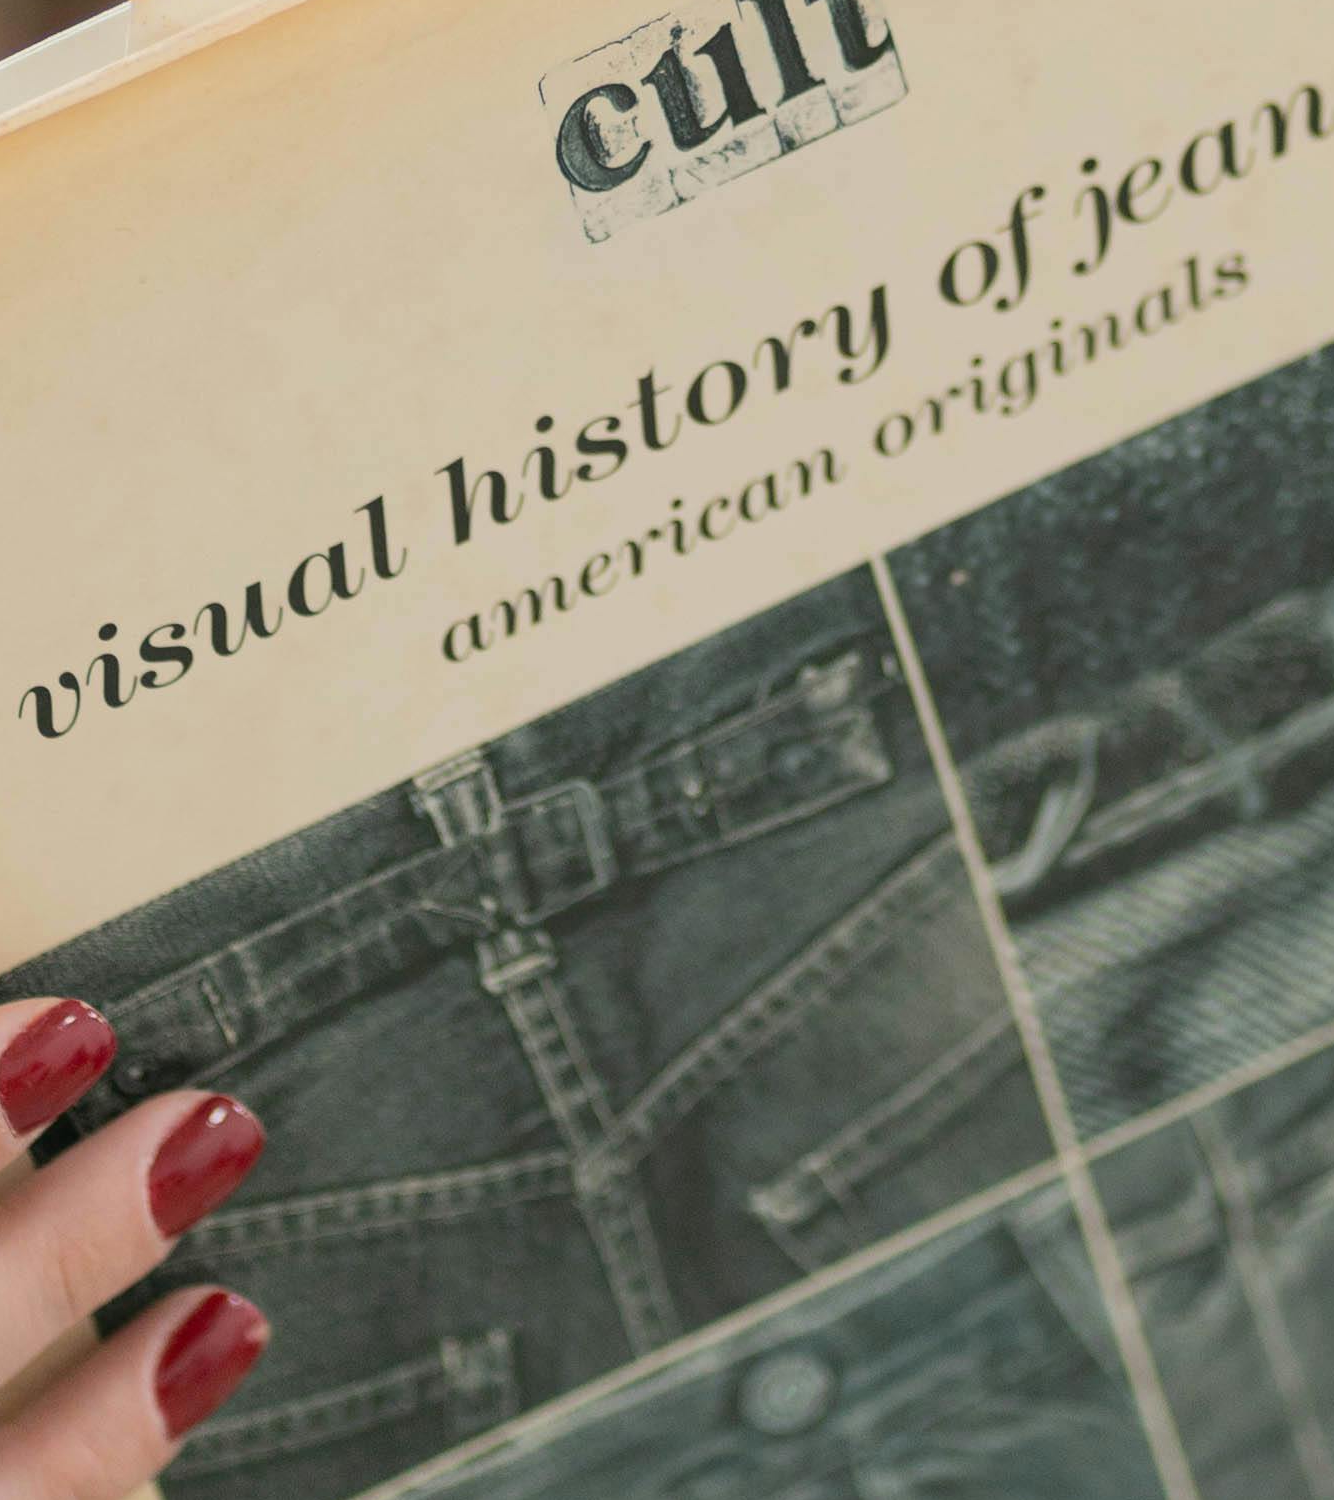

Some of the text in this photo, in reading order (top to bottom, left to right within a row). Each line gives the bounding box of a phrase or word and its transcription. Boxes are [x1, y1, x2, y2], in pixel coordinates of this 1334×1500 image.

[17, 494, 409, 741] visual
[433, 284, 893, 547] history
[937, 184, 1048, 313] of
[441, 254, 1251, 664] american originals
